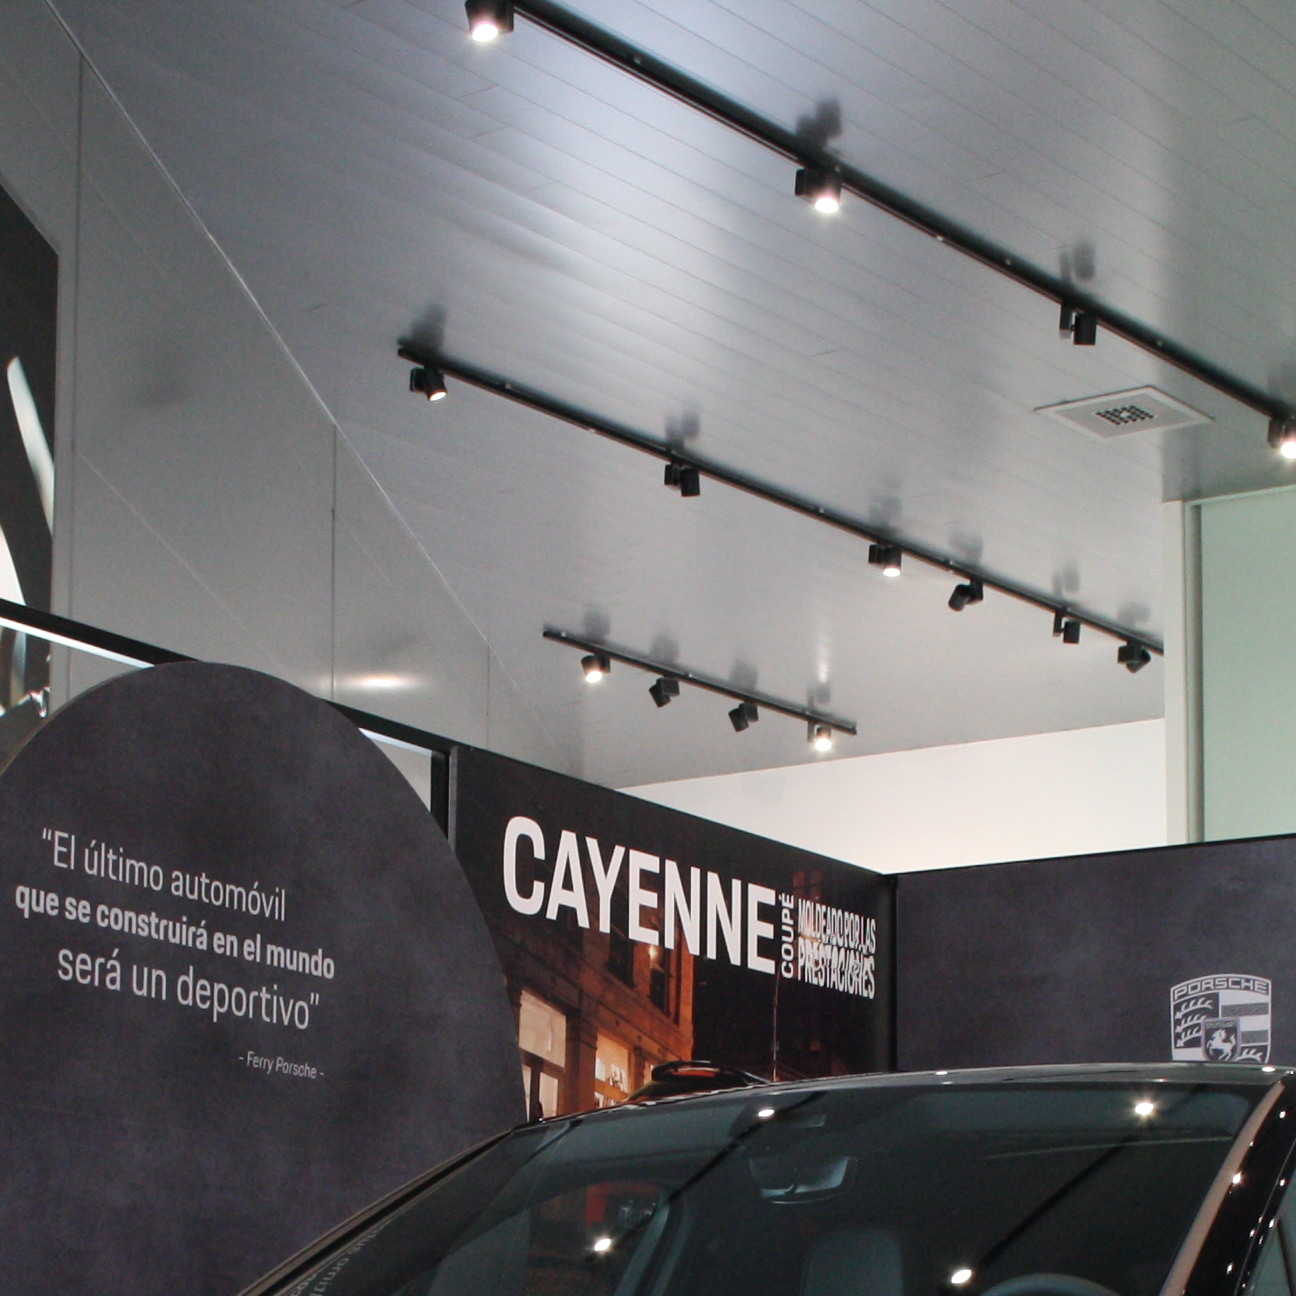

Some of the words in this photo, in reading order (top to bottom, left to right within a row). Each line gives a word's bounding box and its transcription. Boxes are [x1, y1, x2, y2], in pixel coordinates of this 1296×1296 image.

[42, 827, 77, 870] "El
[84, 839, 164, 892] último
[171, 868, 287, 922] automóvil
[503, 815, 777, 976] CAYENNE
[15, 884, 59, 919] que
[64, 895, 91, 923] se
[96, 902, 209, 951] construirá
[213, 930, 239, 959] en
[243, 933, 261, 963] el
[266, 942, 335, 980] mundo
[778, 892, 794, 979] COUPÉ
[798, 898, 843, 948] MOLDEADO
[844, 911, 860, 950] POR
[860, 916, 876, 955] LAS
[798, 936, 875, 999] PRESTACIONES
[57, 948, 121, 992] será
[132, 963, 166, 1001] un
[177, 965, 319, 1030] deportivo"
[1174, 978, 1268, 1001] PORSCHE
[247, 1051, 274, 1075] Ferry
[275, 1056, 317, 1079] Porsche
